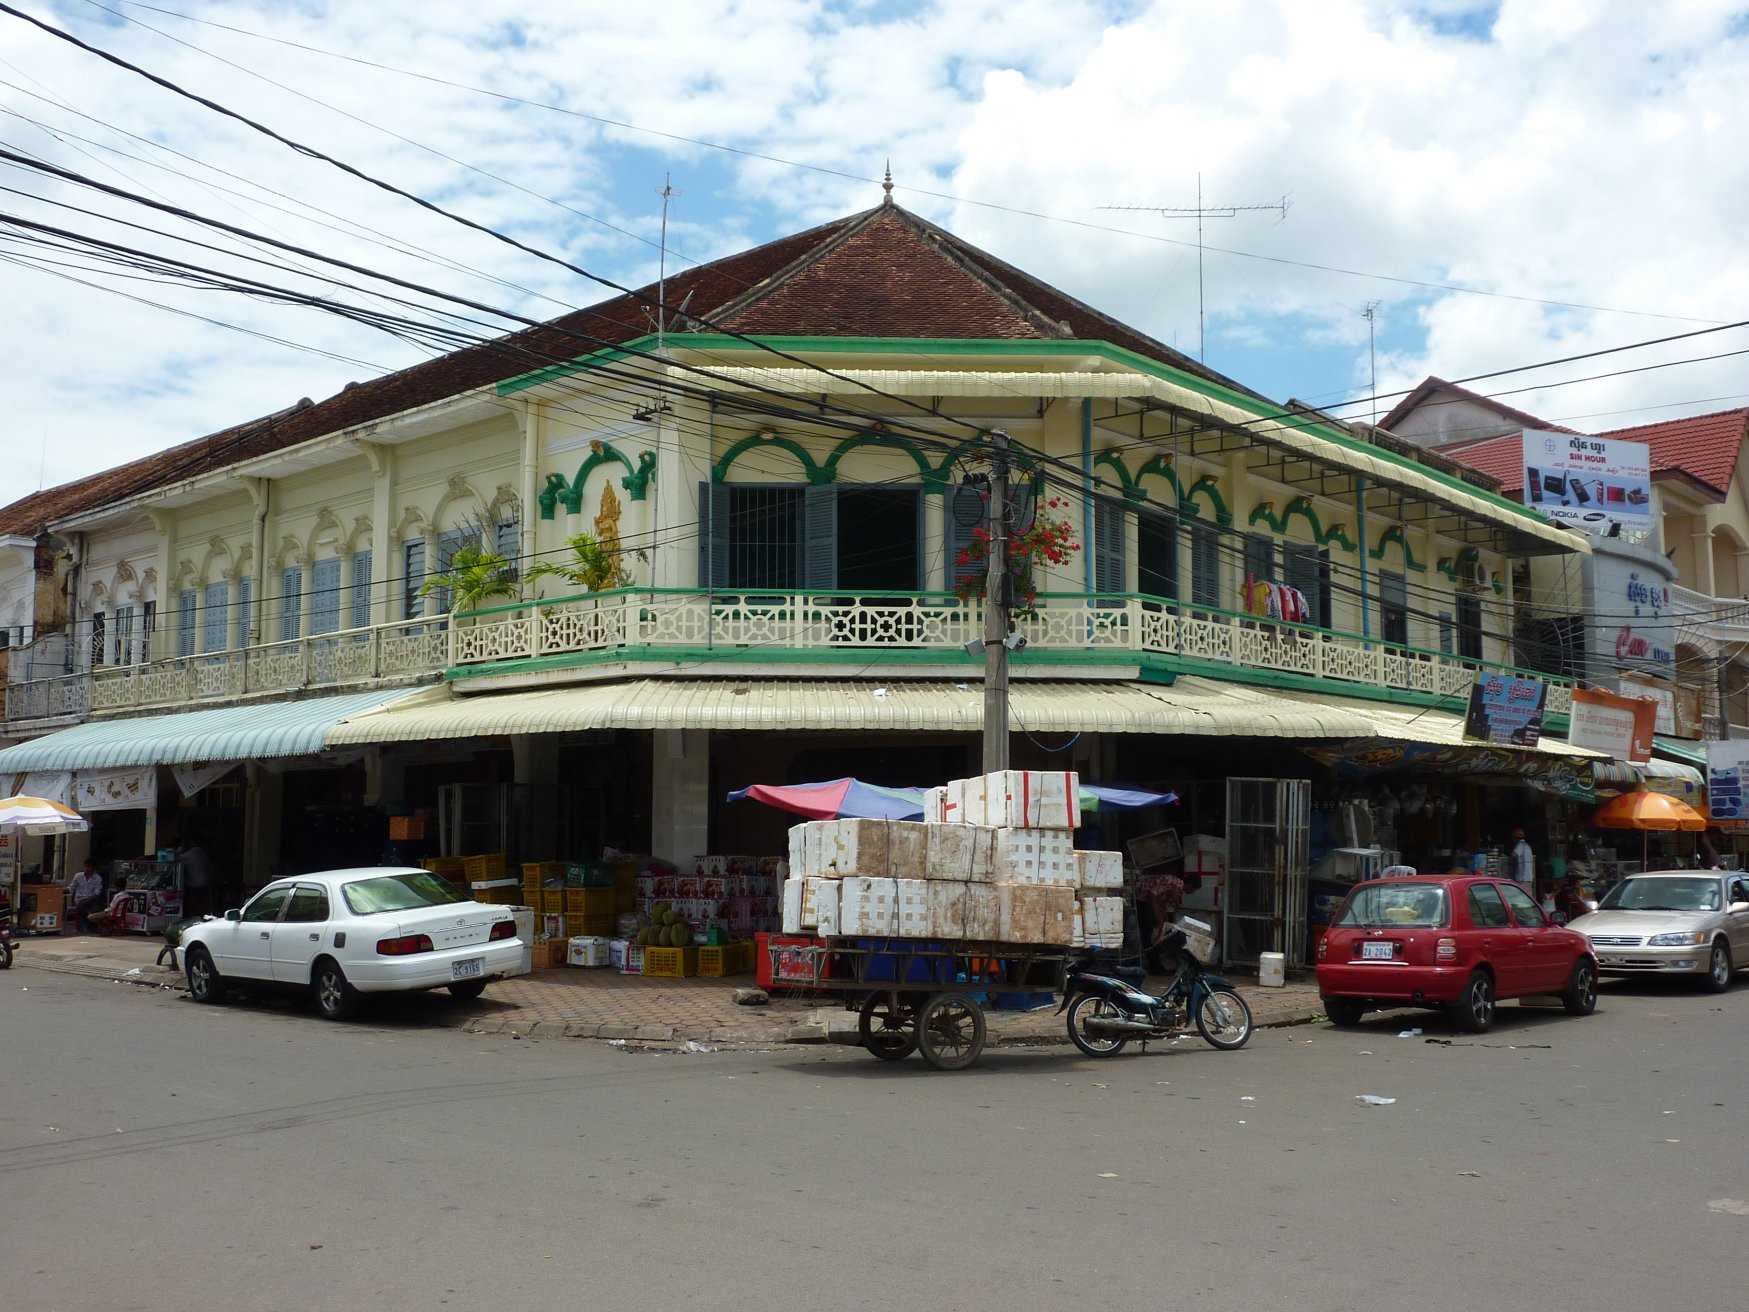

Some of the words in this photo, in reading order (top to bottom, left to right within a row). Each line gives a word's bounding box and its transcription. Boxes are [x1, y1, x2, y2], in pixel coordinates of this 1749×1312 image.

[1569, 452, 1583, 461] SIN
[1584, 454, 1607, 464] HOUR
[1551, 510, 1579, 519] NOKIA
